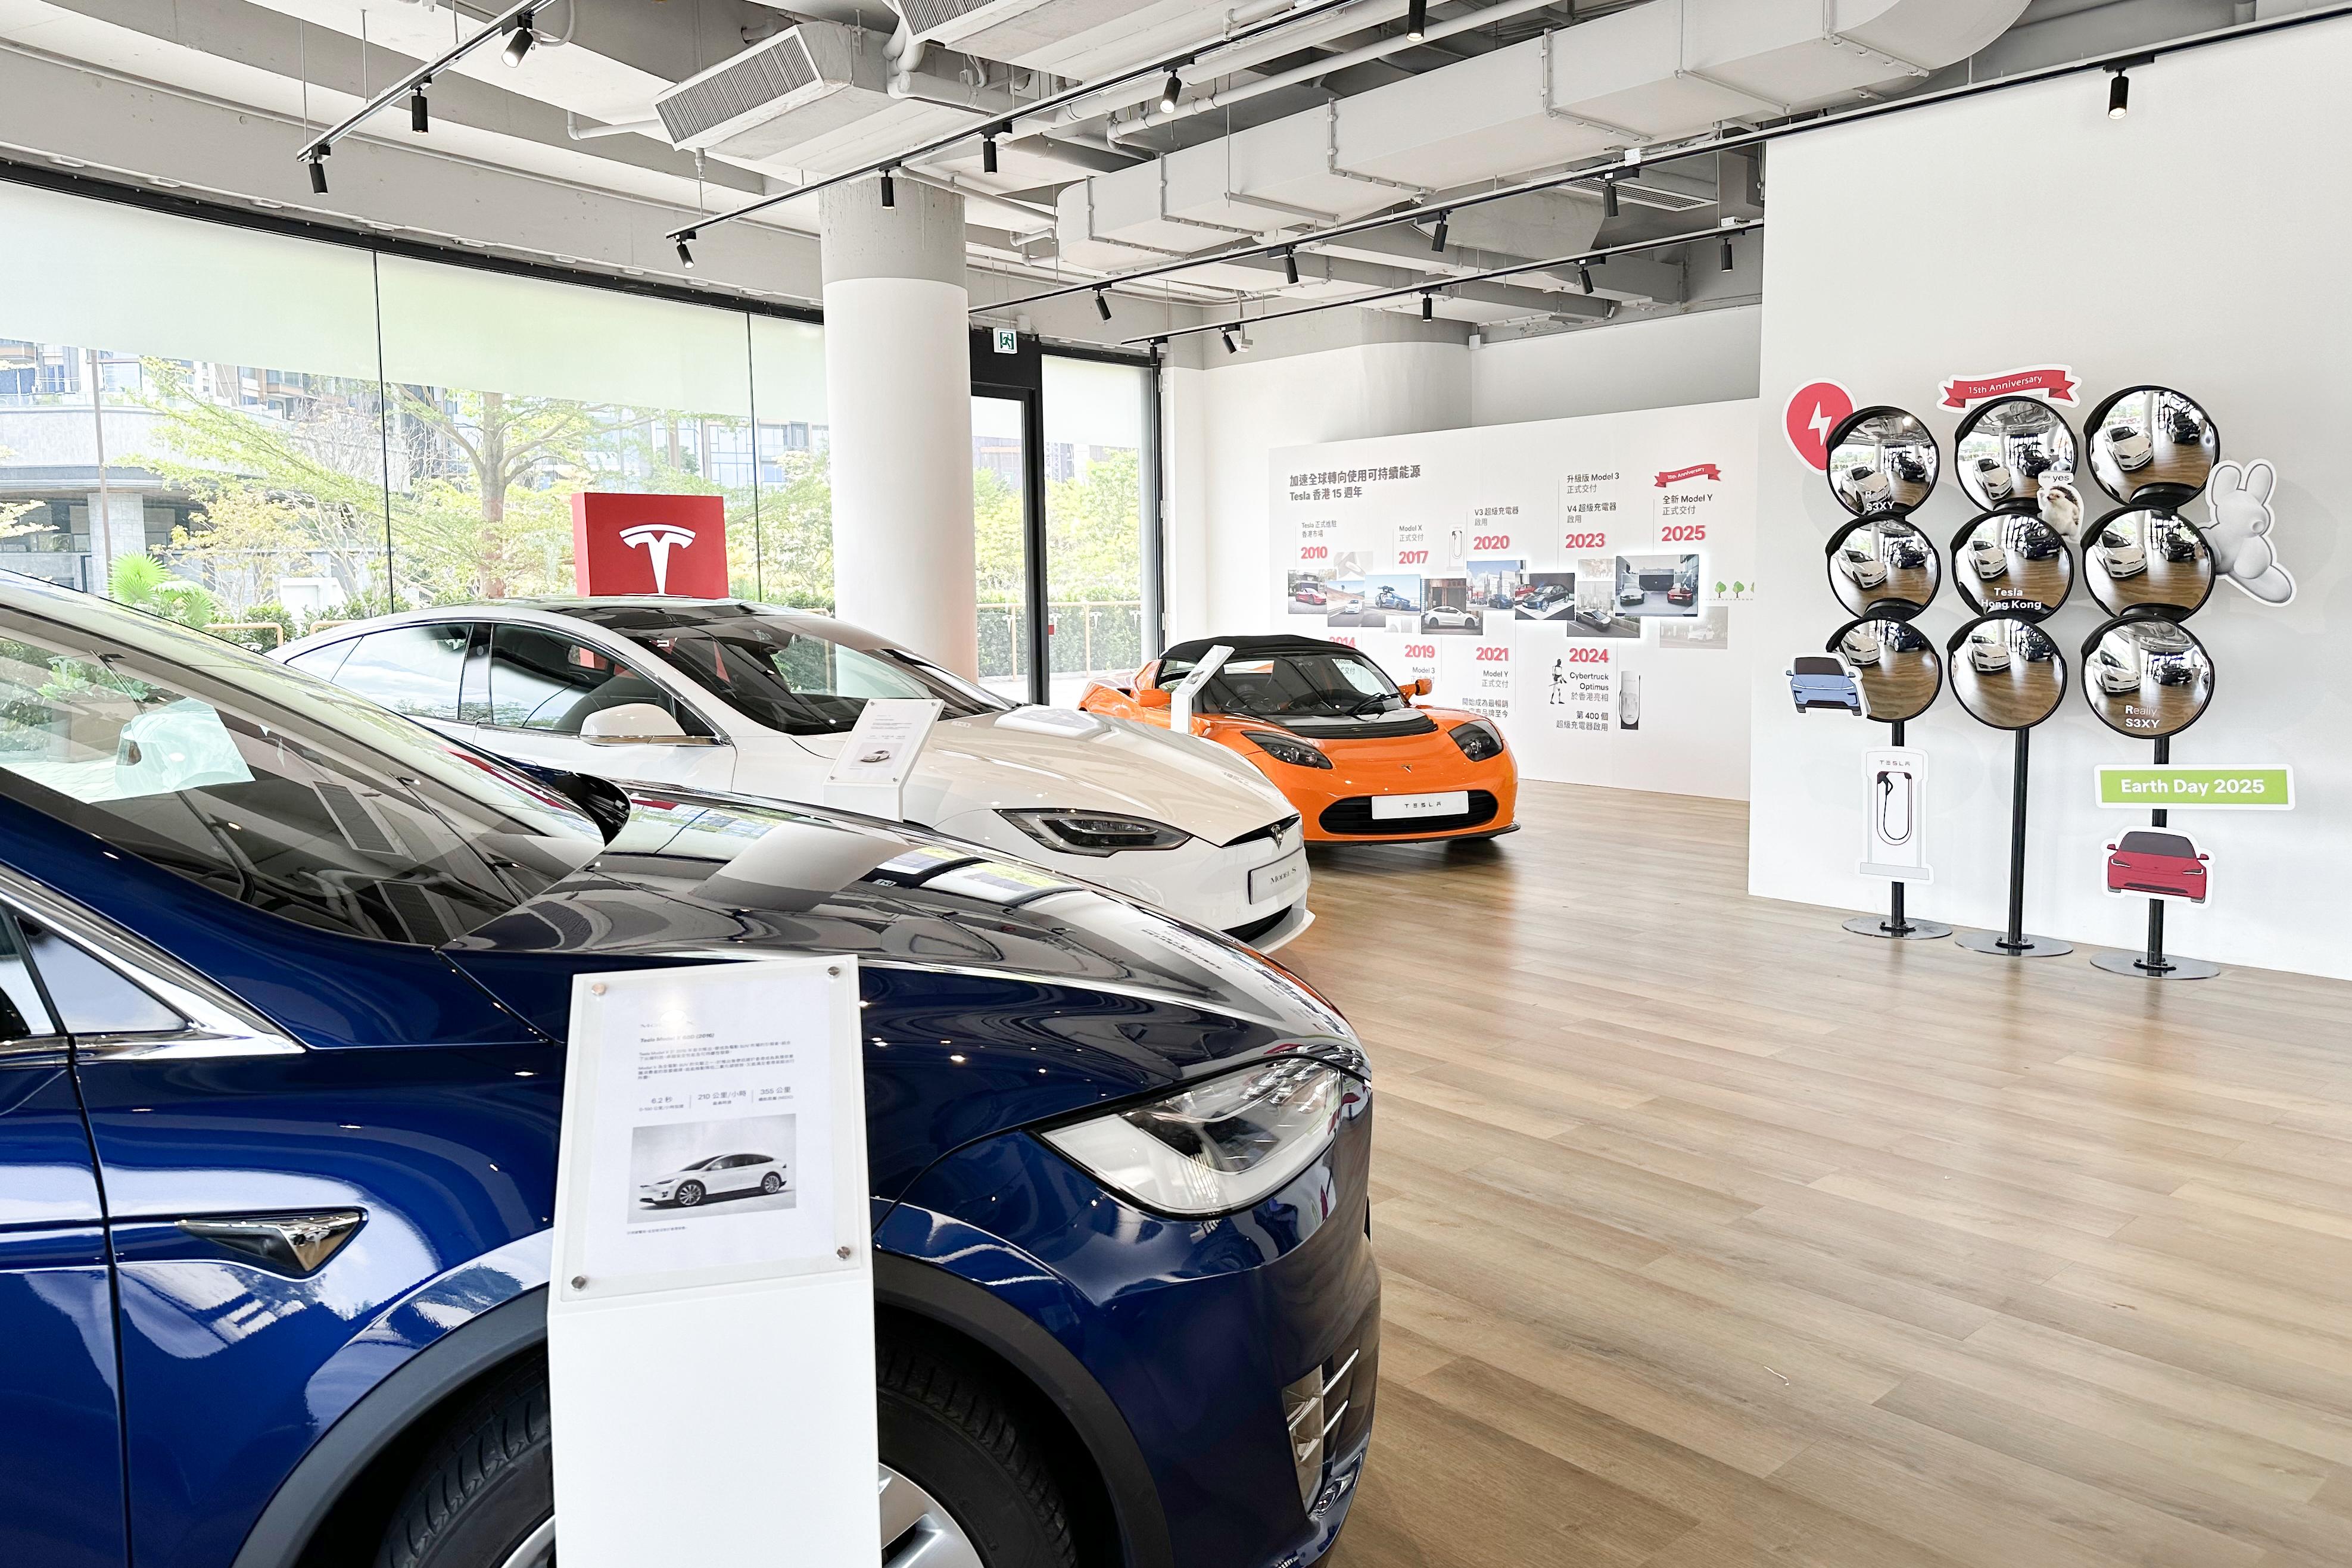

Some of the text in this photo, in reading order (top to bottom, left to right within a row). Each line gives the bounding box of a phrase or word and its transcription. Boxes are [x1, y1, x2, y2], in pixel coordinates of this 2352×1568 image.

[1968, 375, 2043, 394] 15th Anniversary
[1289, 465, 1421, 487] 加速全球轉向使用可持續能源
[1677, 466, 1705, 478] Anniversary
[1566, 473, 1590, 484] 升級版
[1289, 486, 1363, 501] Tesla 香港 15 週年
[1566, 484, 1597, 494] 正式交付
[1662, 494, 1680, 504] 全新
[1681, 494, 1705, 503] Model
[1484, 506, 1519, 516] 超級充電器
[1578, 502, 1617, 512] 超級充電器
[1662, 505, 1696, 516] 正式交付
[1866, 501, 1895, 511] S3XY
[1399, 533, 1424, 542] 正式交付
[1661, 525, 1706, 541] 2025
[1473, 535, 1510, 550] 2020
[1565, 532, 1606, 548] 2023
[1300, 546, 1328, 560] 2010
[1398, 550, 1429, 565] 2017
[1993, 587, 2024, 596] Tesla
[1981, 598, 2042, 610] Hong Kong
[1404, 644, 1435, 659] 2019
[1475, 647, 1509, 662] 2021
[1569, 647, 1610, 663] 2024
[1569, 672, 1609, 680] Cybertruck
[1481, 679, 1509, 688] 正式交付
[1580, 682, 1609, 691] Optimus
[1571, 691, 1609, 702] 於香港亮相
[1576, 710, 1584, 719] 第
[1601, 712, 1609, 721] 個
[2125, 704, 2157, 717] Really
[2125, 718, 2161, 728] S3XY
[2121, 778, 2265, 797] Earth Day 2025
[712, 1090, 746, 1099] 公里/小時
